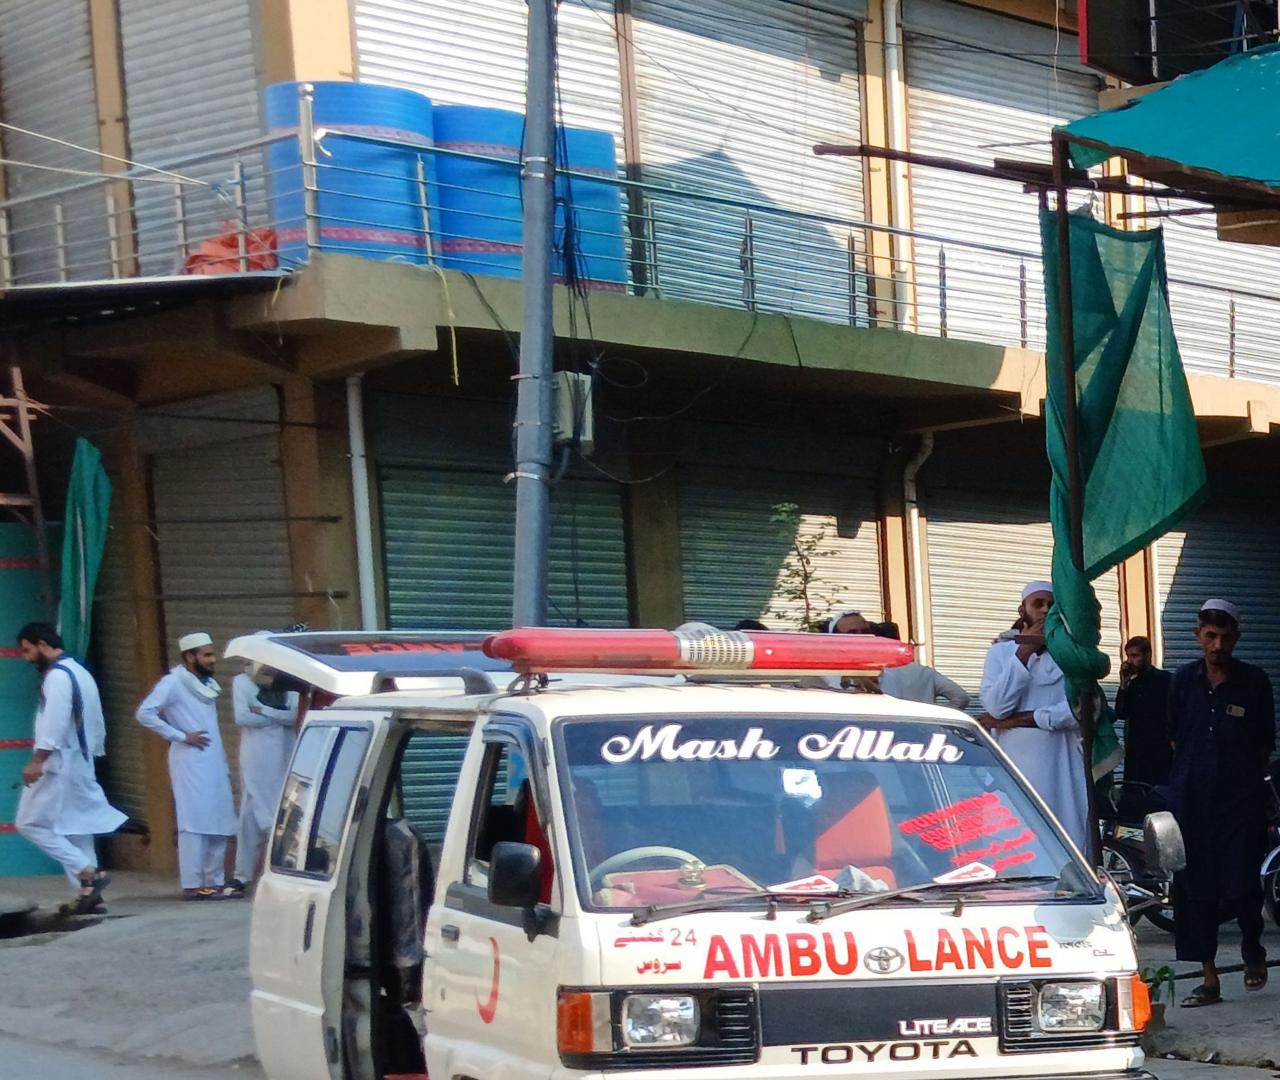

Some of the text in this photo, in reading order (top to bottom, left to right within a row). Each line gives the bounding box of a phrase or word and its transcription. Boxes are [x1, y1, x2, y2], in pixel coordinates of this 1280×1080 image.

[601, 724, 966, 765] Mash Allah
[670, 928, 697, 947] 24
[702, 925, 1053, 979] AMBU LANCE
[790, 1040, 979, 1066] TOYOTA
